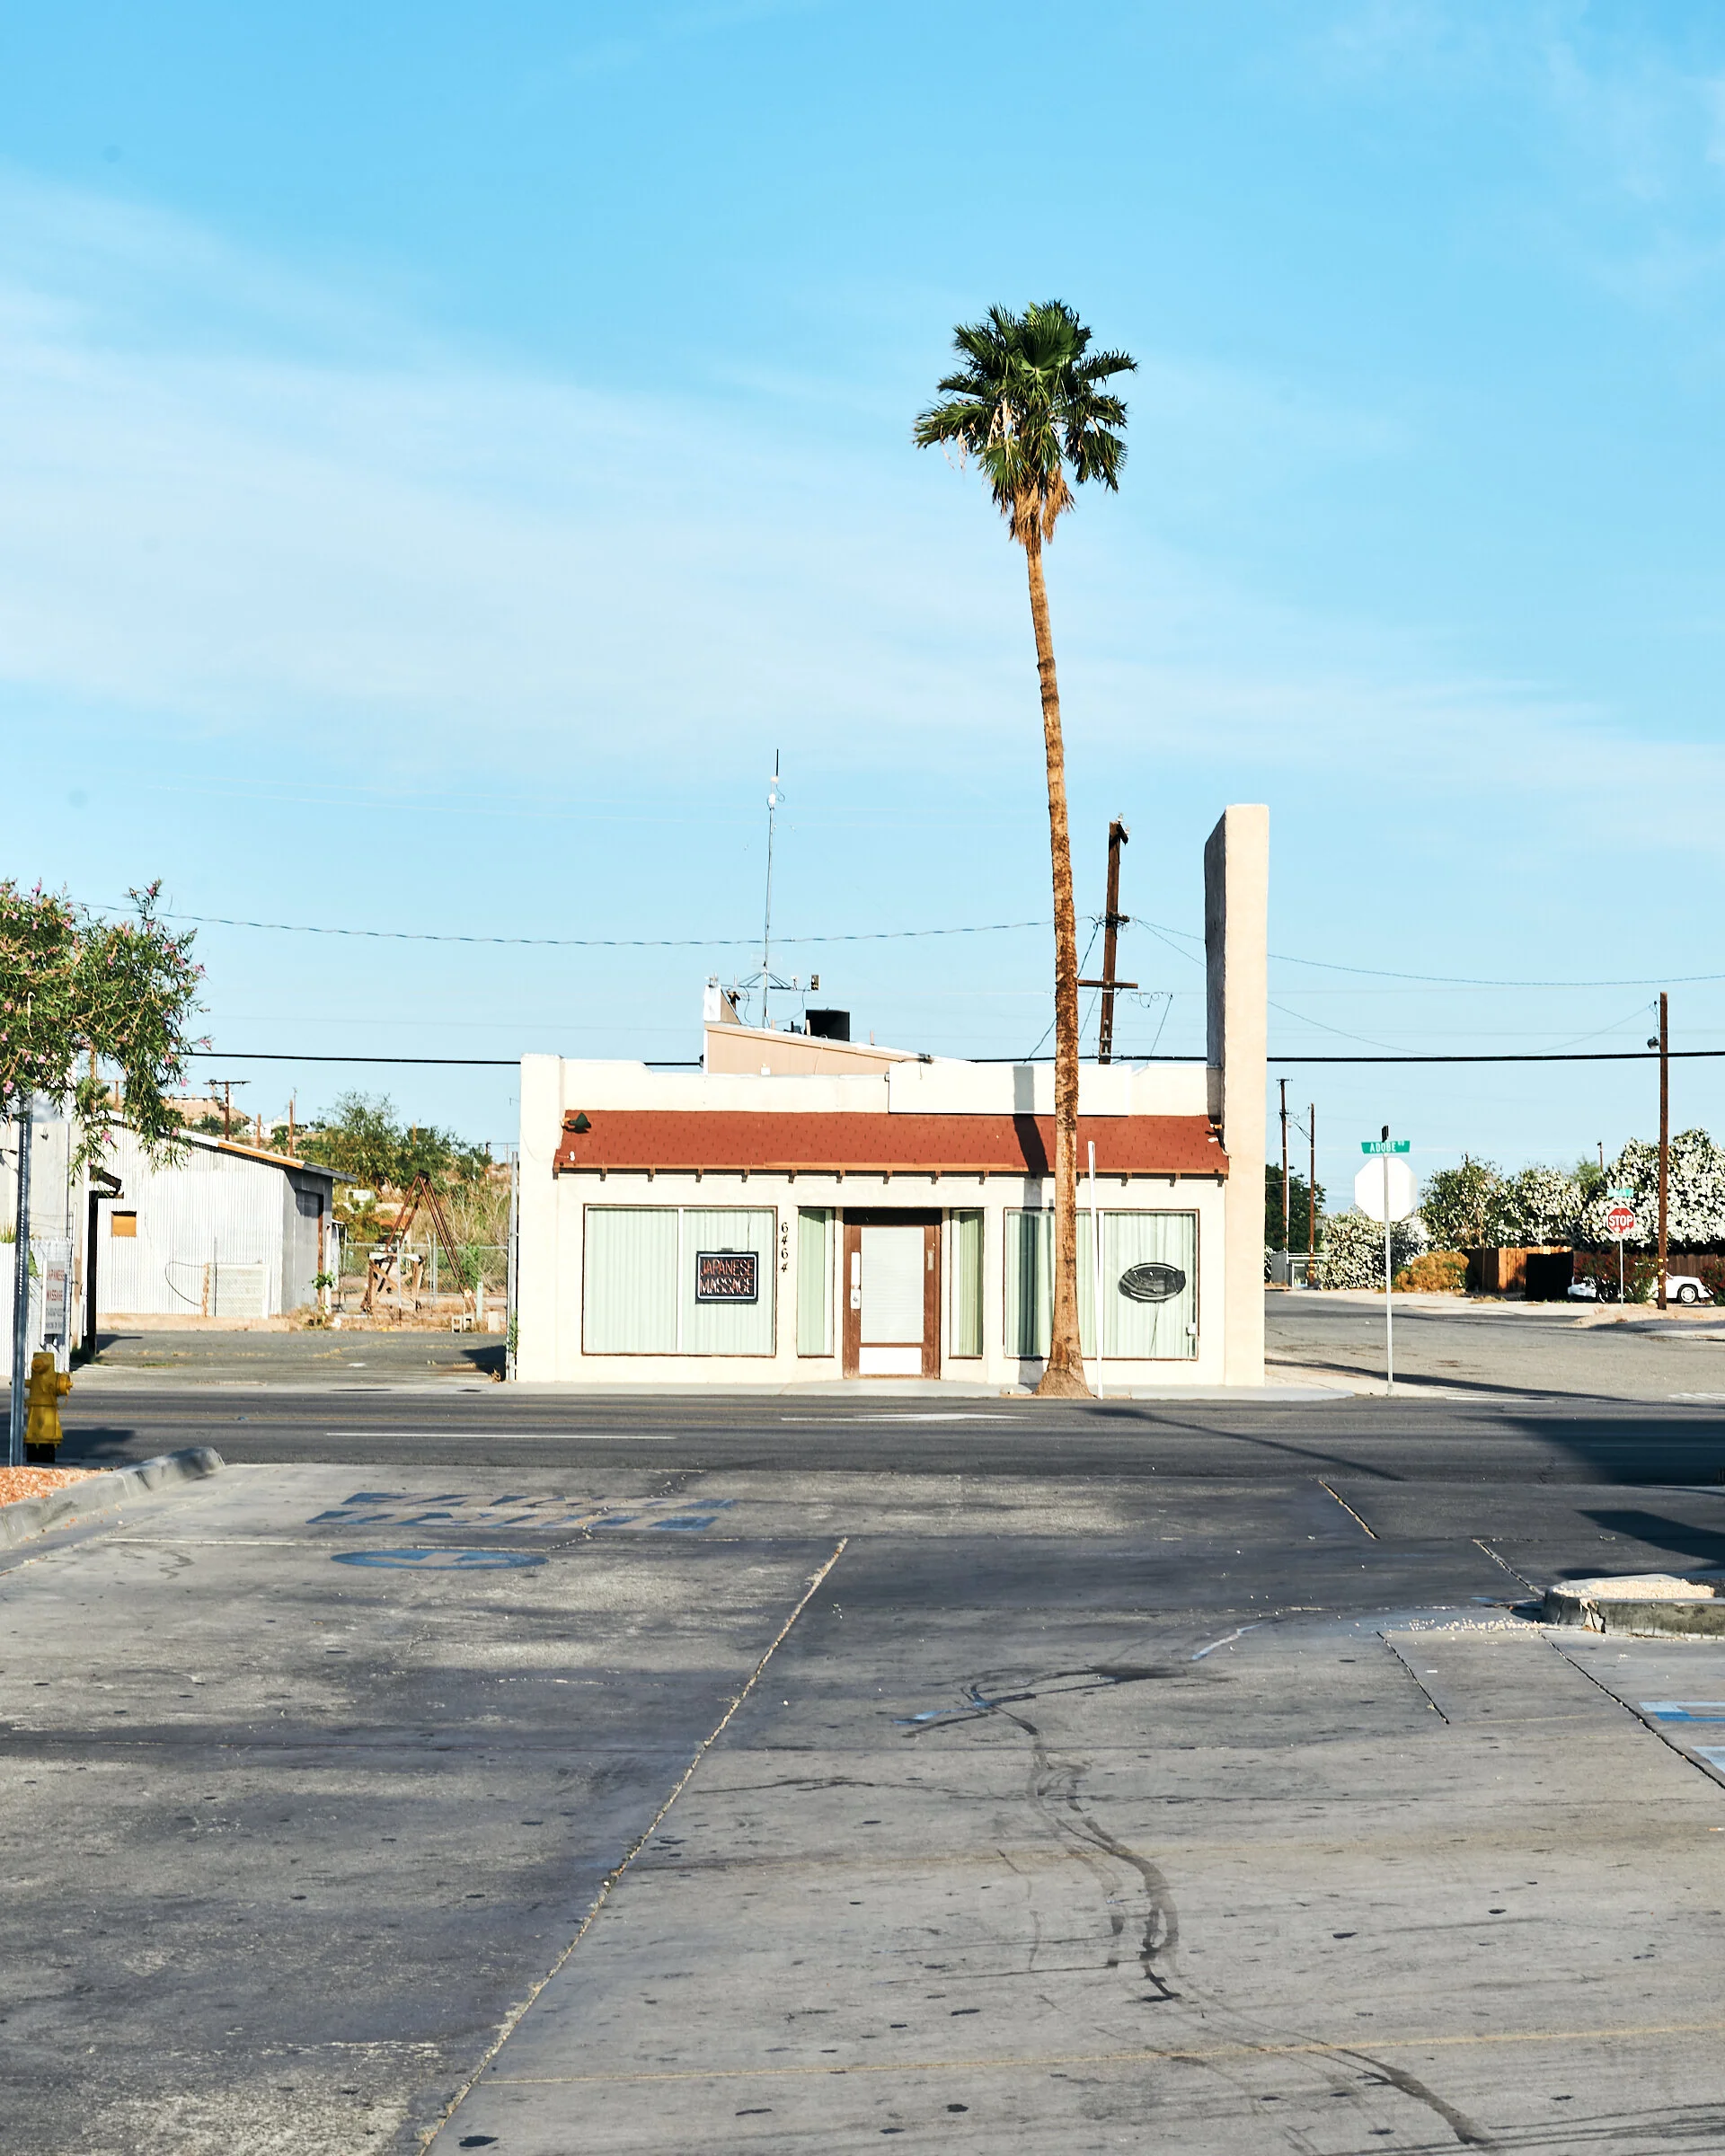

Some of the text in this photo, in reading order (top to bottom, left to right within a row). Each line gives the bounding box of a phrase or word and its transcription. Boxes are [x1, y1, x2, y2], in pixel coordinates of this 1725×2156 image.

[1370, 1142, 1396, 1153] ADOBE
[1608, 1215, 1633, 1227] STOP
[781, 1222, 789, 1272] 6464
[701, 1259, 754, 1277] JAPANESE
[700, 1277, 753, 1295] MASSAGE
